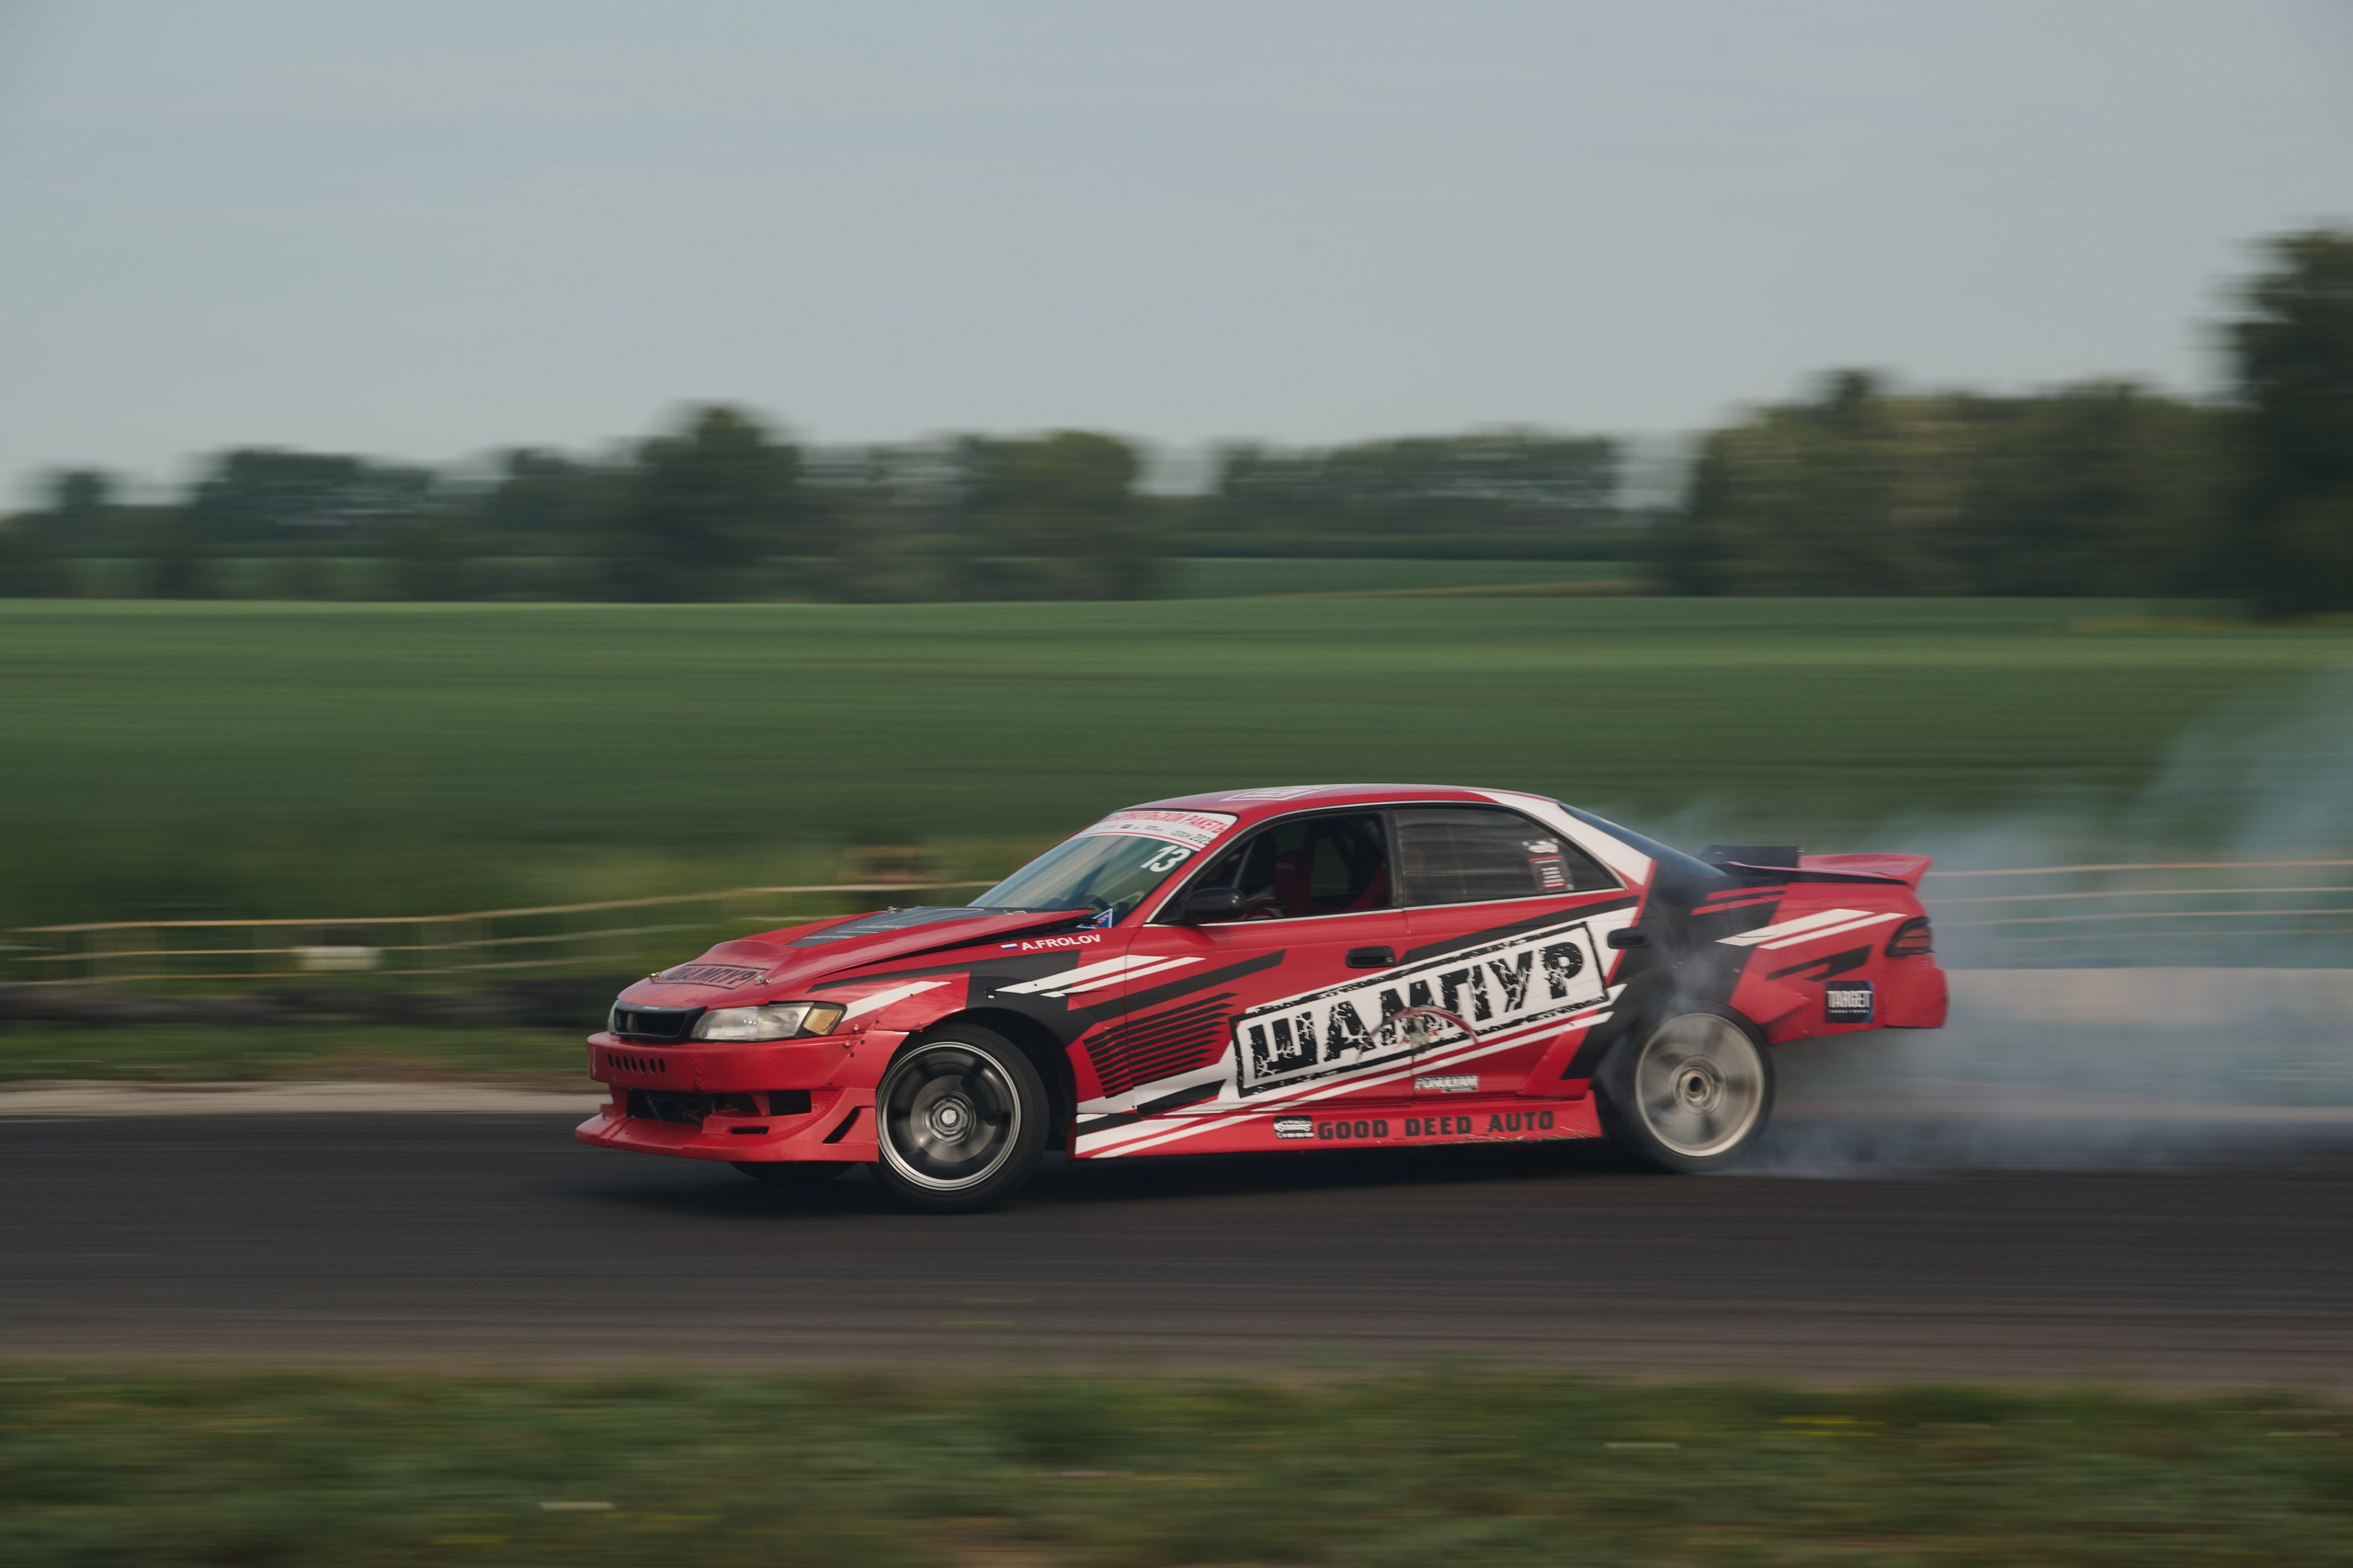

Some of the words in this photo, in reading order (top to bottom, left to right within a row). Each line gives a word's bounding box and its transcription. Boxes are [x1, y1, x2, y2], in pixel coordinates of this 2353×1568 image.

[1140, 845, 1192, 872] 13
[1022, 934, 1101, 951] A.FROLOV
[1247, 940, 1586, 1080] ШАМПУР
